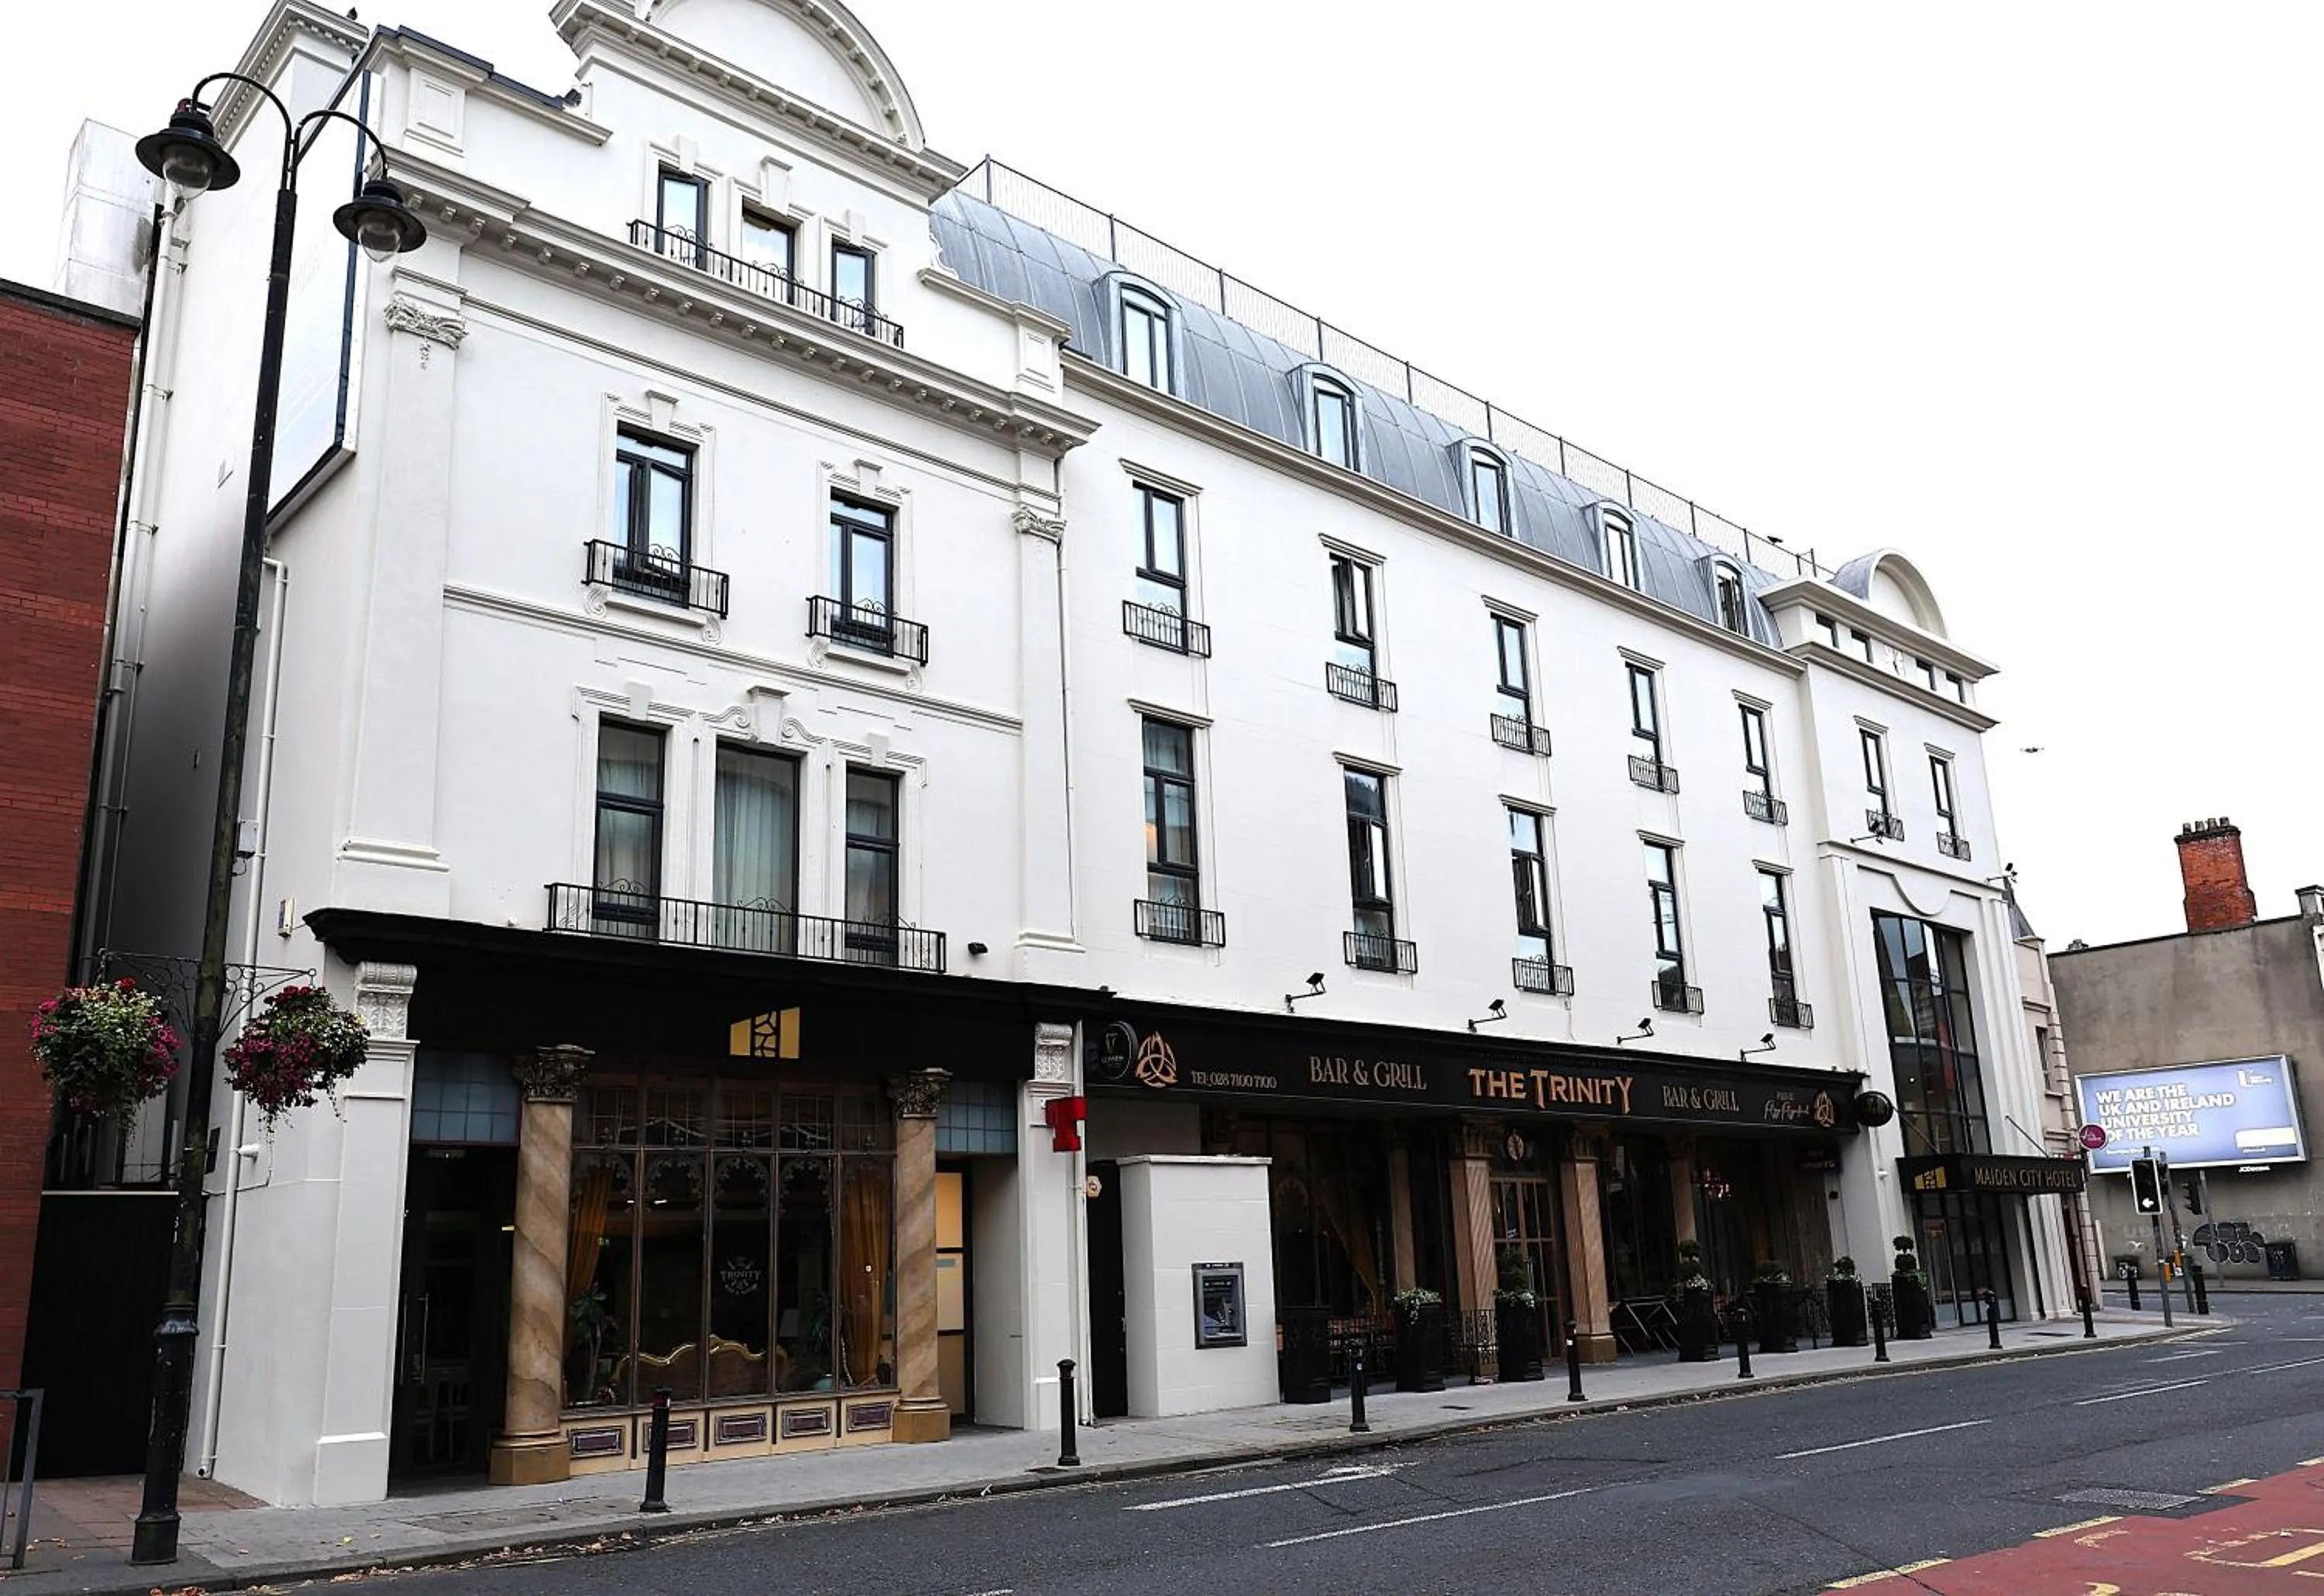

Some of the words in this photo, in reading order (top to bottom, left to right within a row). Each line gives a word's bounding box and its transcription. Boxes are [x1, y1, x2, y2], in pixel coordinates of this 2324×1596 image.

[1310, 1056, 1349, 1084] BAR
[1353, 1059, 1370, 1085] &
[1373, 1061, 1427, 1090] GRILL
[1469, 1068, 1527, 1099] THE
[1530, 1068, 1634, 1114] TRINITY
[1662, 1085, 1689, 1109] BAR
[1690, 1087, 1702, 1109] &
[1704, 1089, 1739, 1111] GRILL
[2095, 1090, 2121, 1103] WE
[2125, 1087, 2155, 1101] ARE
[2157, 1084, 2187, 1098] THE
[2099, 1103, 2123, 1116] UK
[2125, 1100, 2161, 1115] AND
[2164, 1093, 2235, 1110] IRELAND
[2101, 1110, 2194, 1129] UNIVERSITY
[2106, 1128, 2123, 1141] OF
[2126, 1126, 2156, 1140] THE
[2157, 1123, 2199, 1137] YEAR
[1975, 1167, 2016, 1188] MAIDEN
[2019, 1169, 2043, 1187] CITY
[2045, 1171, 2077, 1188] HOTEL
[720, 1269, 761, 1281] TRINITY
